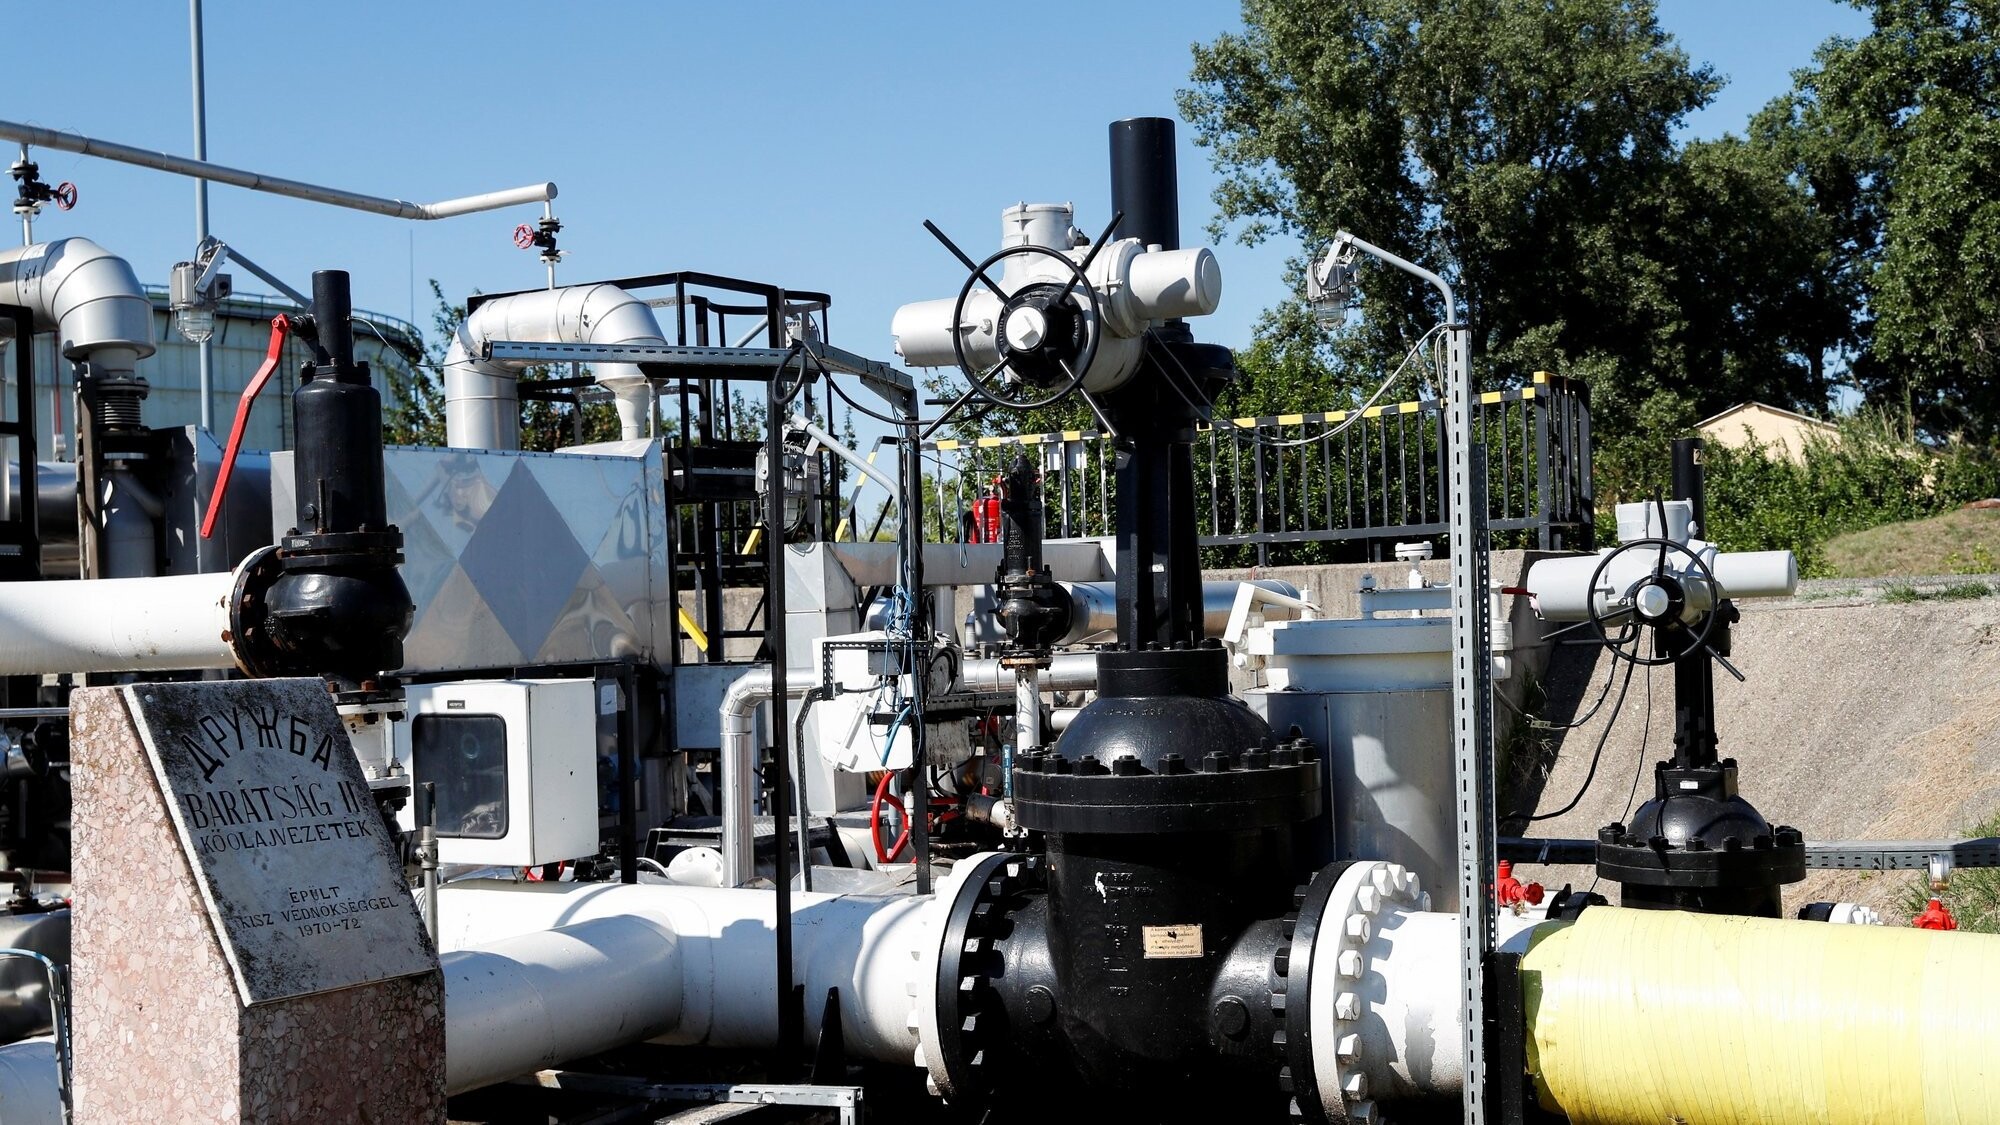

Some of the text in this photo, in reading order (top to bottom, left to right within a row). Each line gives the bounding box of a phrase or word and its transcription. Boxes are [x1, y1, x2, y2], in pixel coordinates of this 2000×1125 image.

[1695, 449, 1702, 463] 2
[181, 707, 333, 784] ДРУЖБА
[184, 775, 361, 829] BARÁTSÁG II
[289, 885, 341, 904] ÉPÜLT
[280, 896, 399, 922] VÉDNÖKSÉGGEL
[298, 917, 362, 938] 1970-72
